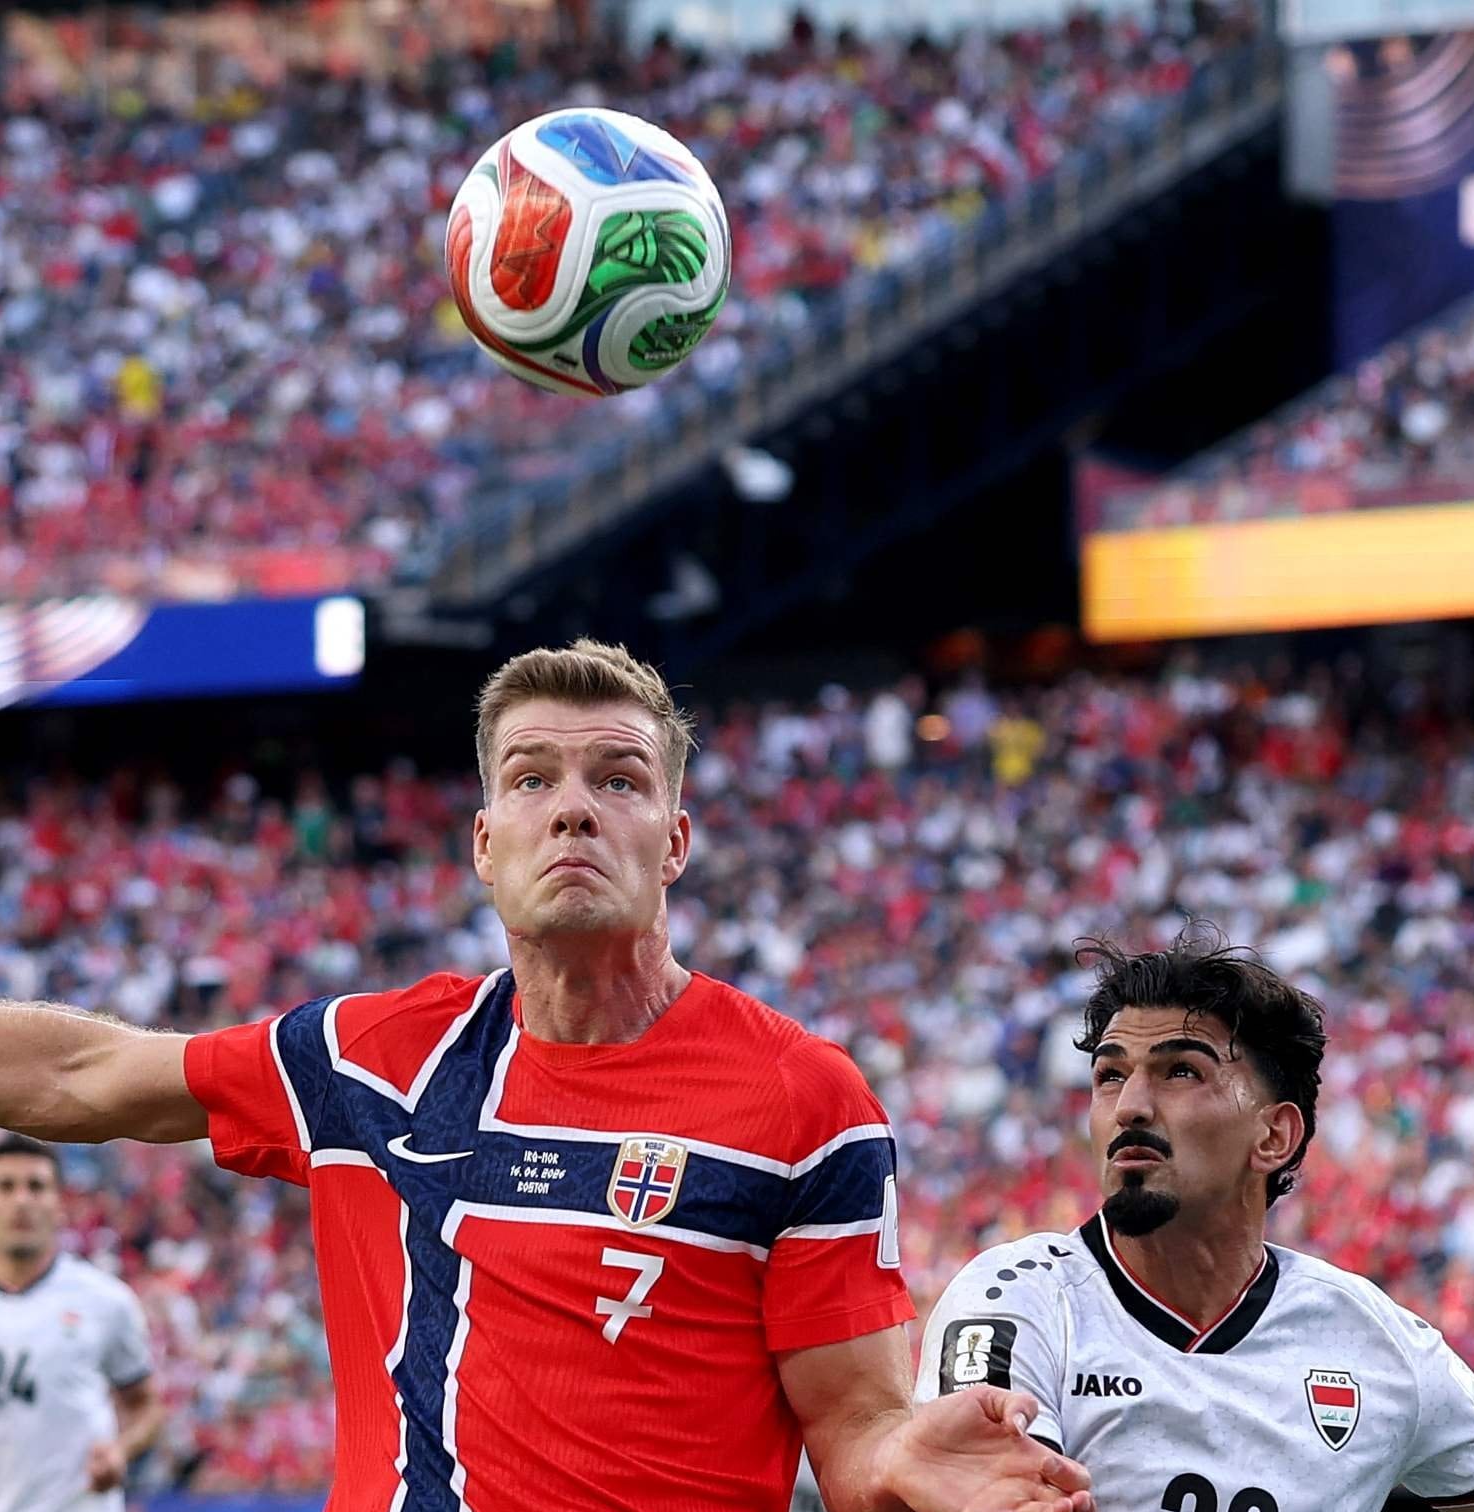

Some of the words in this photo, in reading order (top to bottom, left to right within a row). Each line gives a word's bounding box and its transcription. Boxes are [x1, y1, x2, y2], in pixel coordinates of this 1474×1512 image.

[516, 1180, 550, 1195] BOSTON
[595, 1247, 664, 1346] 7
[1071, 1373, 1143, 1397] JAKO
[1316, 1374, 1347, 1385] IRAQ
